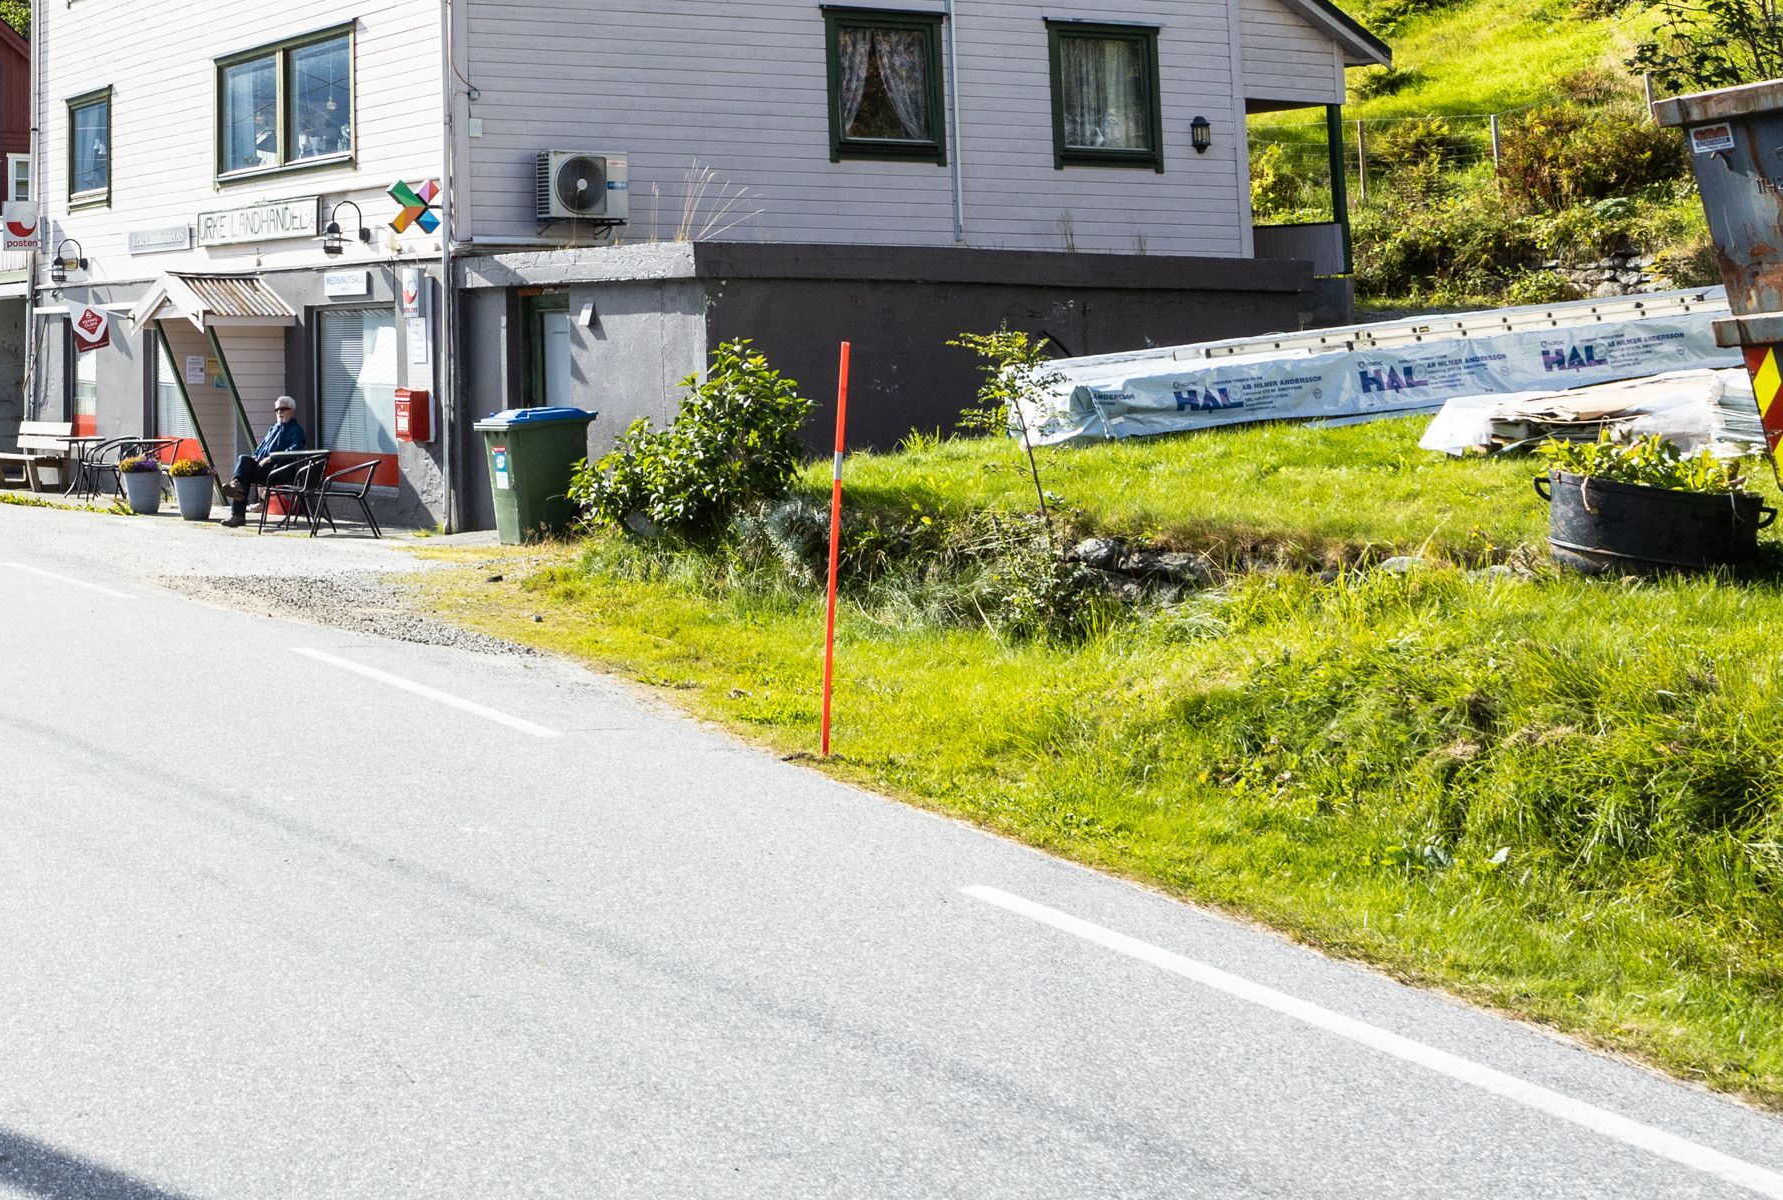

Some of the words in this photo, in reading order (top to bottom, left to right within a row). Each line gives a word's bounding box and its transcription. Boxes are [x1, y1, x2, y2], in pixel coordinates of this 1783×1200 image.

[200, 215, 227, 240] URKE
[231, 206, 308, 238] LANDHANDEL
[7, 239, 38, 248] posten
[1643, 332, 1685, 343] ANDERSSON
[1465, 354, 1507, 364] ANDERSSON
[1541, 344, 1609, 373] HAL
[1279, 376, 1322, 386] ANDERSSON
[1359, 366, 1428, 393] HAL
[1173, 386, 1243, 413] HAL
